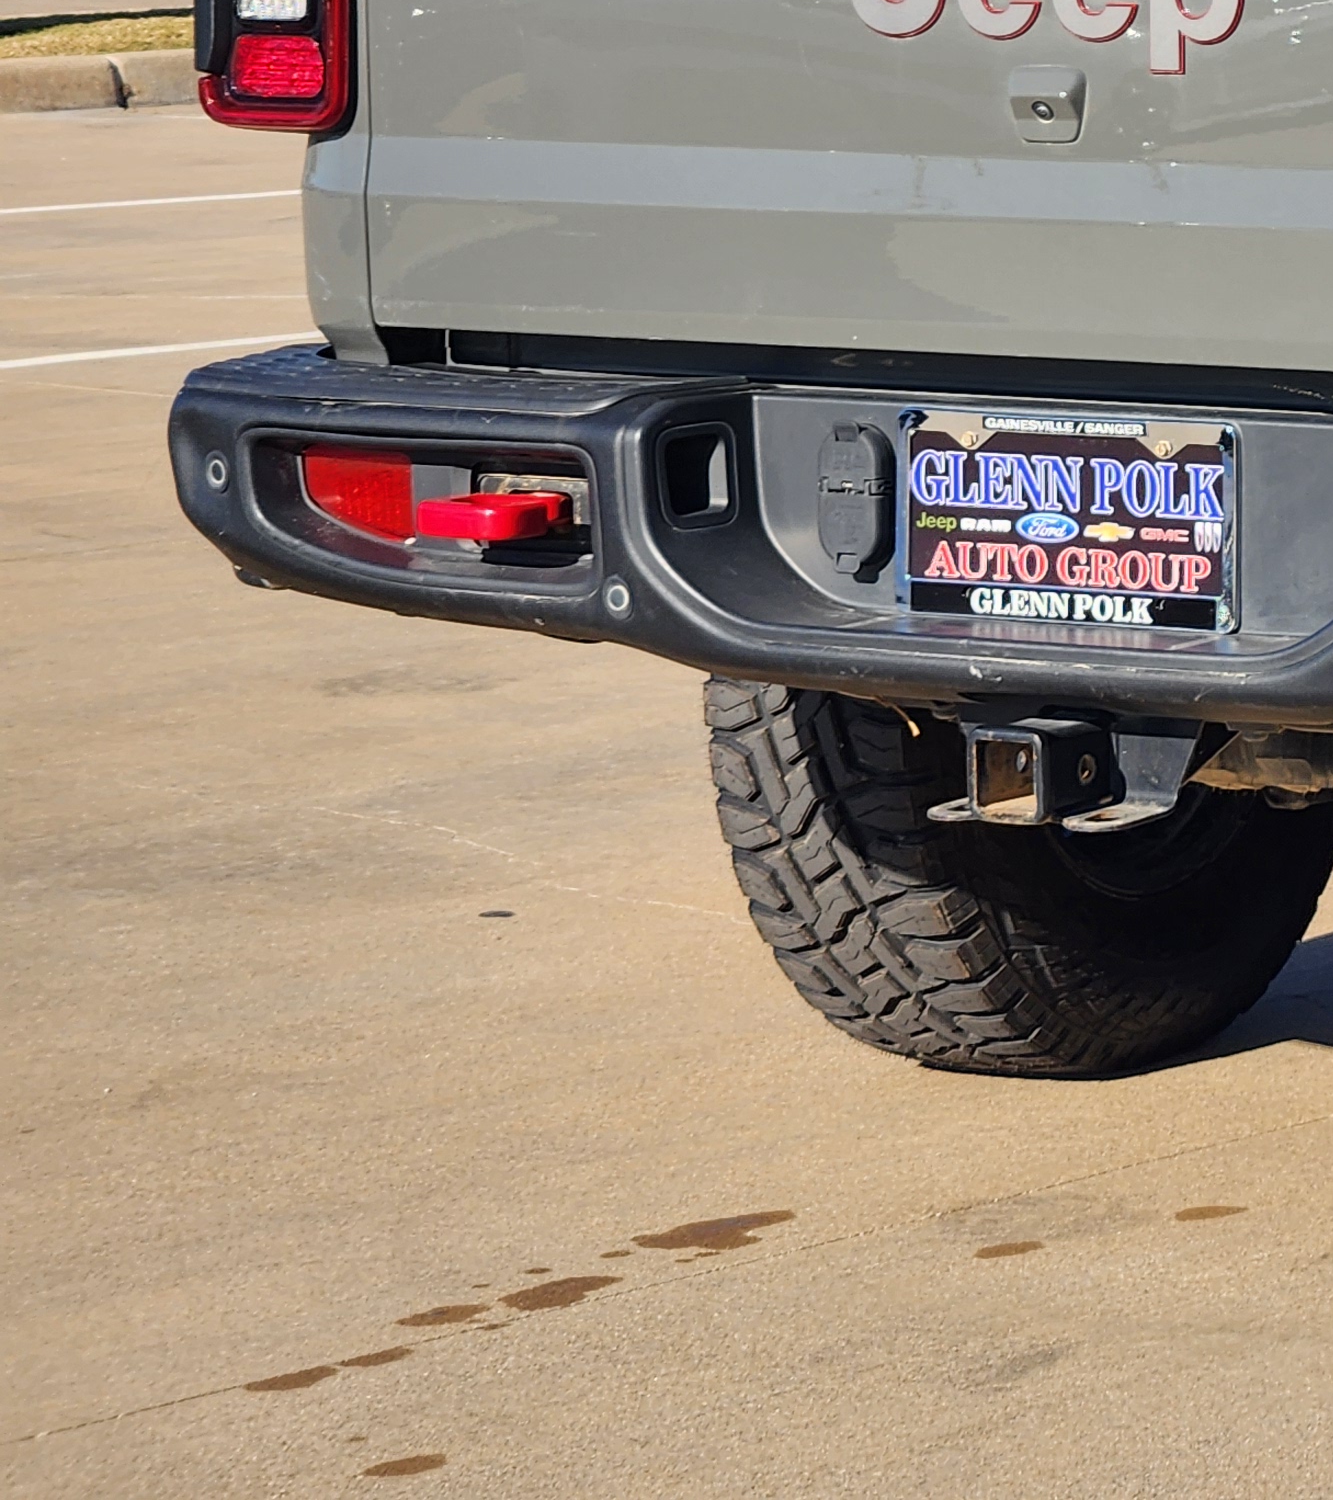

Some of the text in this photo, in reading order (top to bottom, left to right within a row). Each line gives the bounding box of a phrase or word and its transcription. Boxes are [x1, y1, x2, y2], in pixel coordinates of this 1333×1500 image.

[985, 416, 1074, 434] GAINESVILLE
[1084, 422, 1144, 436] SANGER
[910, 448, 1225, 522] GLENN POLK
[916, 511, 1190, 543] Jeep RAM Ford GMC
[925, 540, 1211, 594] AUTO GROUP
[969, 587, 1154, 625] GLENN POLK
